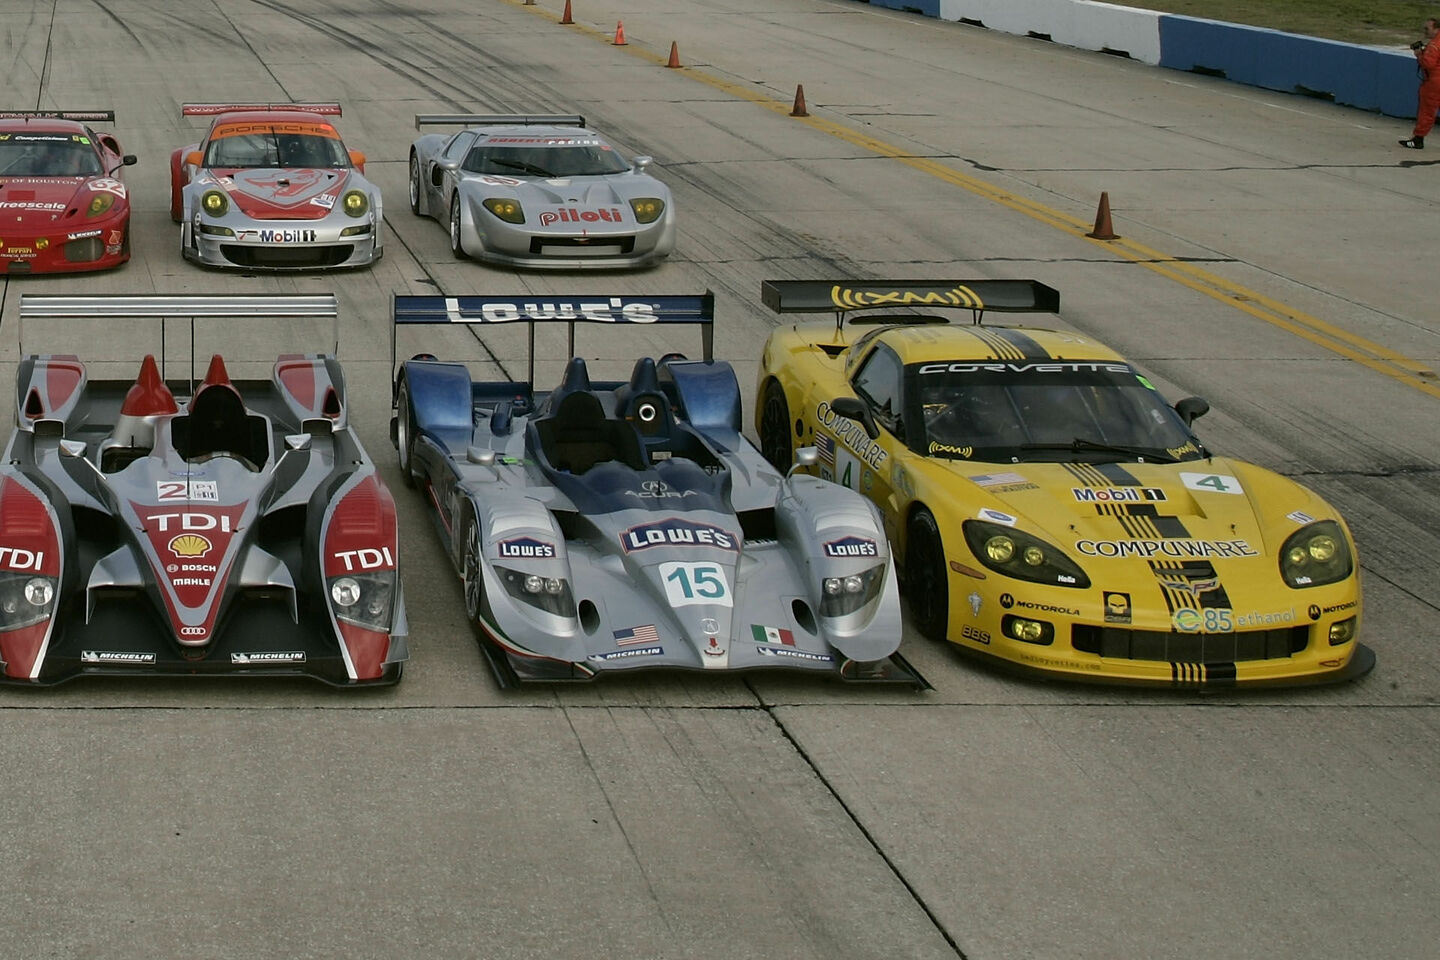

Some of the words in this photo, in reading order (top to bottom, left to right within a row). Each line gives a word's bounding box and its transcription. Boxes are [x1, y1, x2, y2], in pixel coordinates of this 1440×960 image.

[220, 125, 330, 135] PORSCHE
[539, 208, 623, 227] piloti
[77, 230, 102, 239] MICHELIN
[261, 230, 300, 242] Mobil
[445, 297, 660, 324] LOWE'S
[918, 362, 1132, 375] CORVETTE
[816, 401, 888, 471] COMPUWARE
[842, 460, 852, 489] 4
[159, 483, 187, 499] 2
[1195, 475, 1231, 492] 4
[624, 489, 699, 499] ACURA
[1072, 487, 1140, 502] Mobil
[146, 512, 230, 533] TDI
[629, 528, 732, 548] LOWE'S
[502, 543, 553, 557] LOWE'S
[827, 542, 876, 556] LOWE'S
[1075, 539, 1259, 558] COMPUWARE
[334, 546, 394, 571] TDI
[181, 564, 217, 572] BOSCH
[173, 577, 211, 586] MAHLE
[666, 566, 726, 600] 15
[1016, 600, 1081, 616] MOTOROLA
[1237, 607, 1297, 627] ethanol
[963, 626, 990, 643] BBS
[99, 653, 155, 661] MICHELIN
[249, 652, 304, 660] MICHELIN
[606, 647, 661, 660] MICHELIN
[776, 649, 831, 661] MICHELIN
